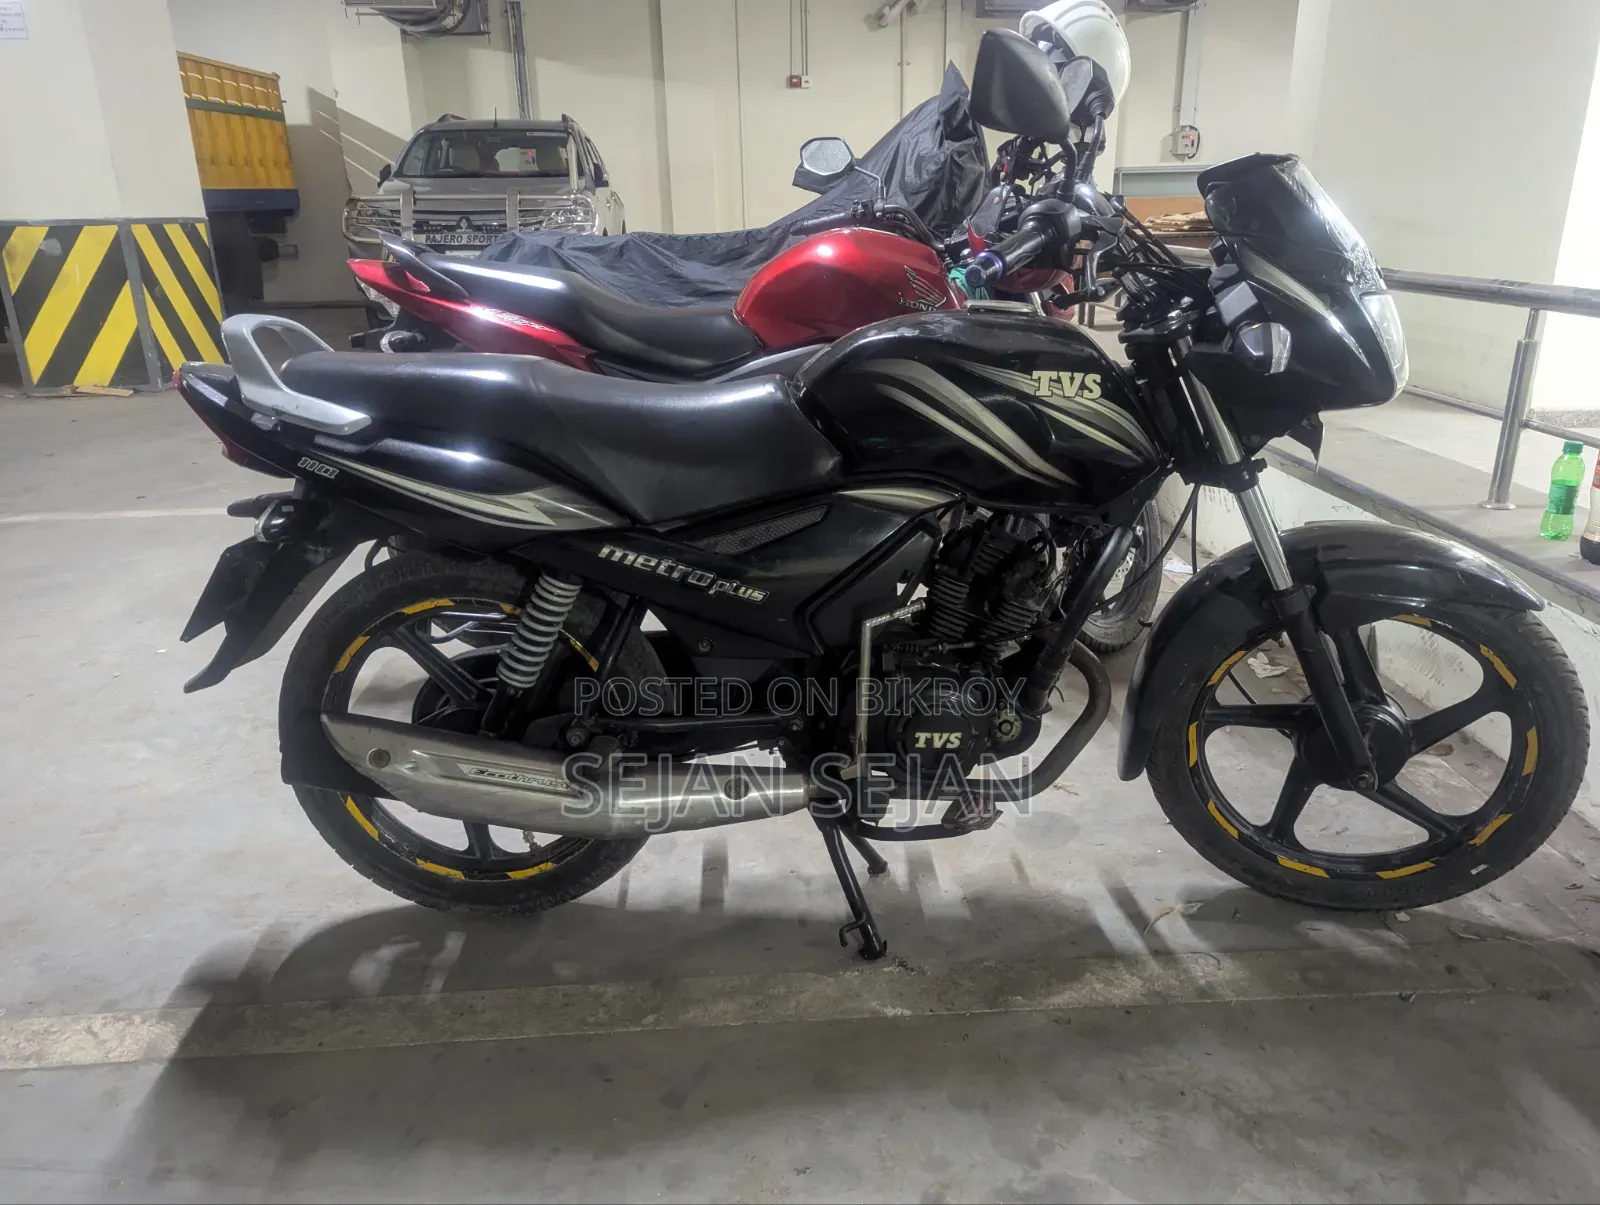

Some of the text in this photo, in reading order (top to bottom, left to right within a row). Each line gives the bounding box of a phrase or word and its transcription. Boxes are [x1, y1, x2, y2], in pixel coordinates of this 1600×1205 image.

[425, 234, 499, 244] PAJERO SPORT
[899, 297, 939, 312] HOND
[1031, 370, 1102, 400] TVS
[914, 732, 962, 749] TVS
